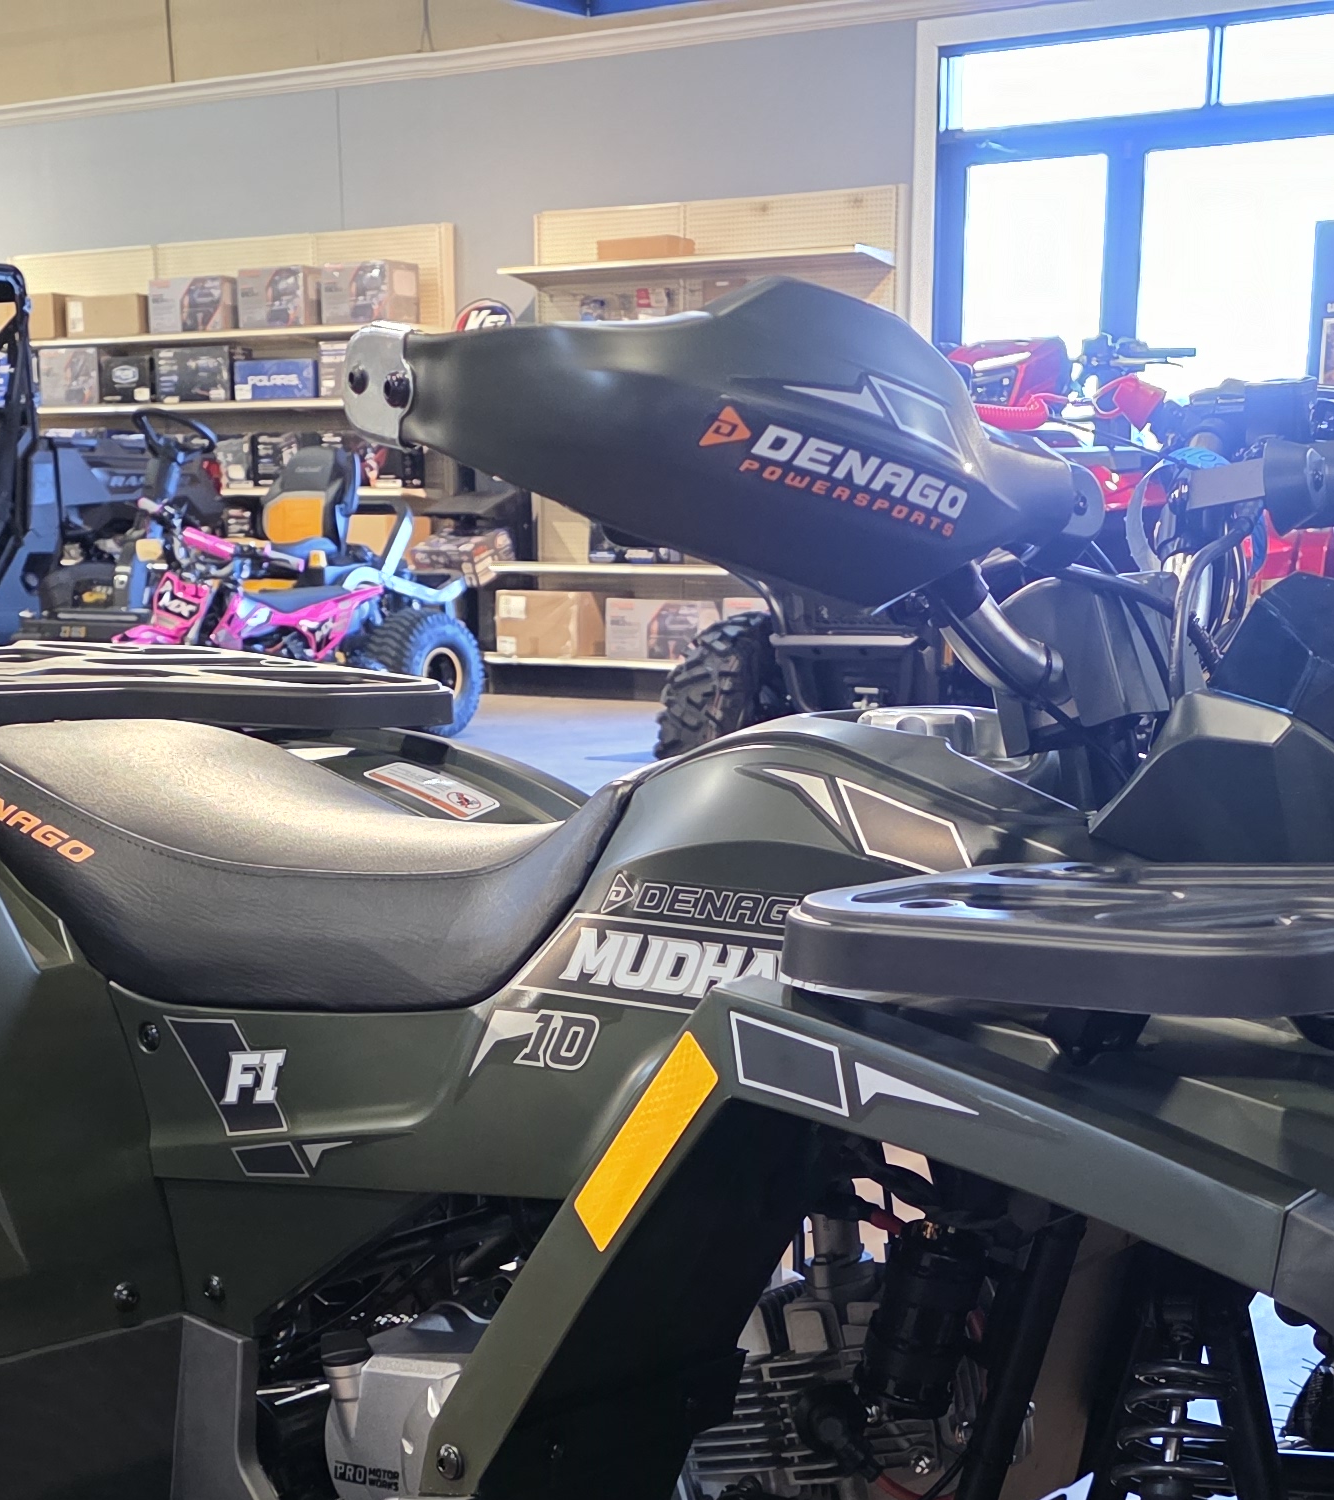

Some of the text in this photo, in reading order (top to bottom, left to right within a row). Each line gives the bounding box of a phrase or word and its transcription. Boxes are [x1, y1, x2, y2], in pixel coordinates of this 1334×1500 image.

[738, 458, 956, 540] POWERSPORTS
[750, 423, 968, 520] DENAGO
[634, 881, 800, 929] DENAG
[559, 926, 797, 999] MUDHA
[513, 1008, 600, 1072] 10
[220, 1049, 287, 1105] FI
[335, 1462, 366, 1484] PRO
[368, 1467, 400, 1481] MOTOR
[368, 1477, 399, 1492] WORKS
